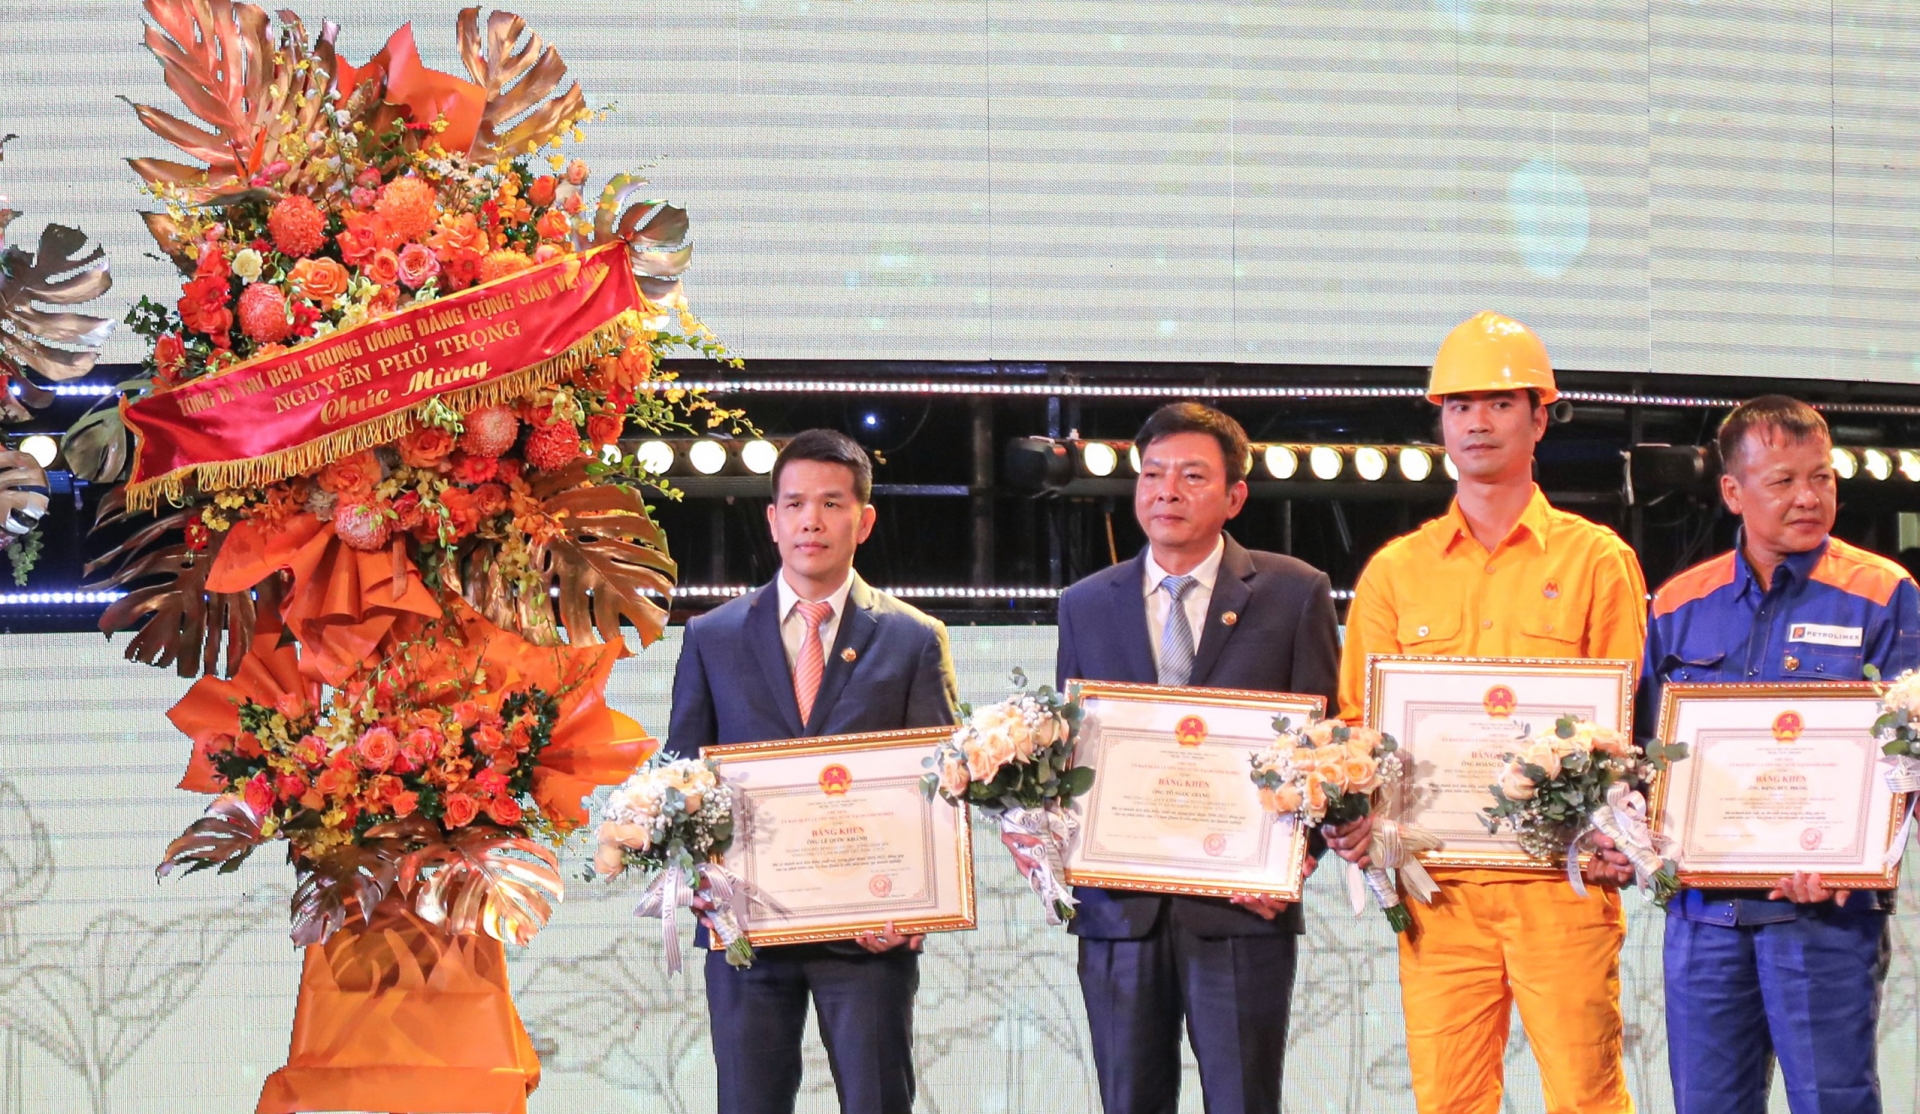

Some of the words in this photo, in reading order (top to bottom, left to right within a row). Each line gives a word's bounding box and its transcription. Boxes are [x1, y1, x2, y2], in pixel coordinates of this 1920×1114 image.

[266, 360, 303, 388] BCH
[304, 338, 363, 373] TRUNG
[366, 322, 414, 353] ƯƠNG
[416, 308, 465, 337] ĐẢNG
[467, 292, 515, 320] CỘNG
[519, 279, 554, 305] SẢN
[272, 362, 372, 414] NGUYỄN
[378, 342, 428, 377] PHÚ
[436, 319, 521, 357] TRỌNG
[320, 387, 391, 425] Chúc
[401, 360, 492, 396] Mừng
[1806, 631, 1860, 640] PETROLIMEX
